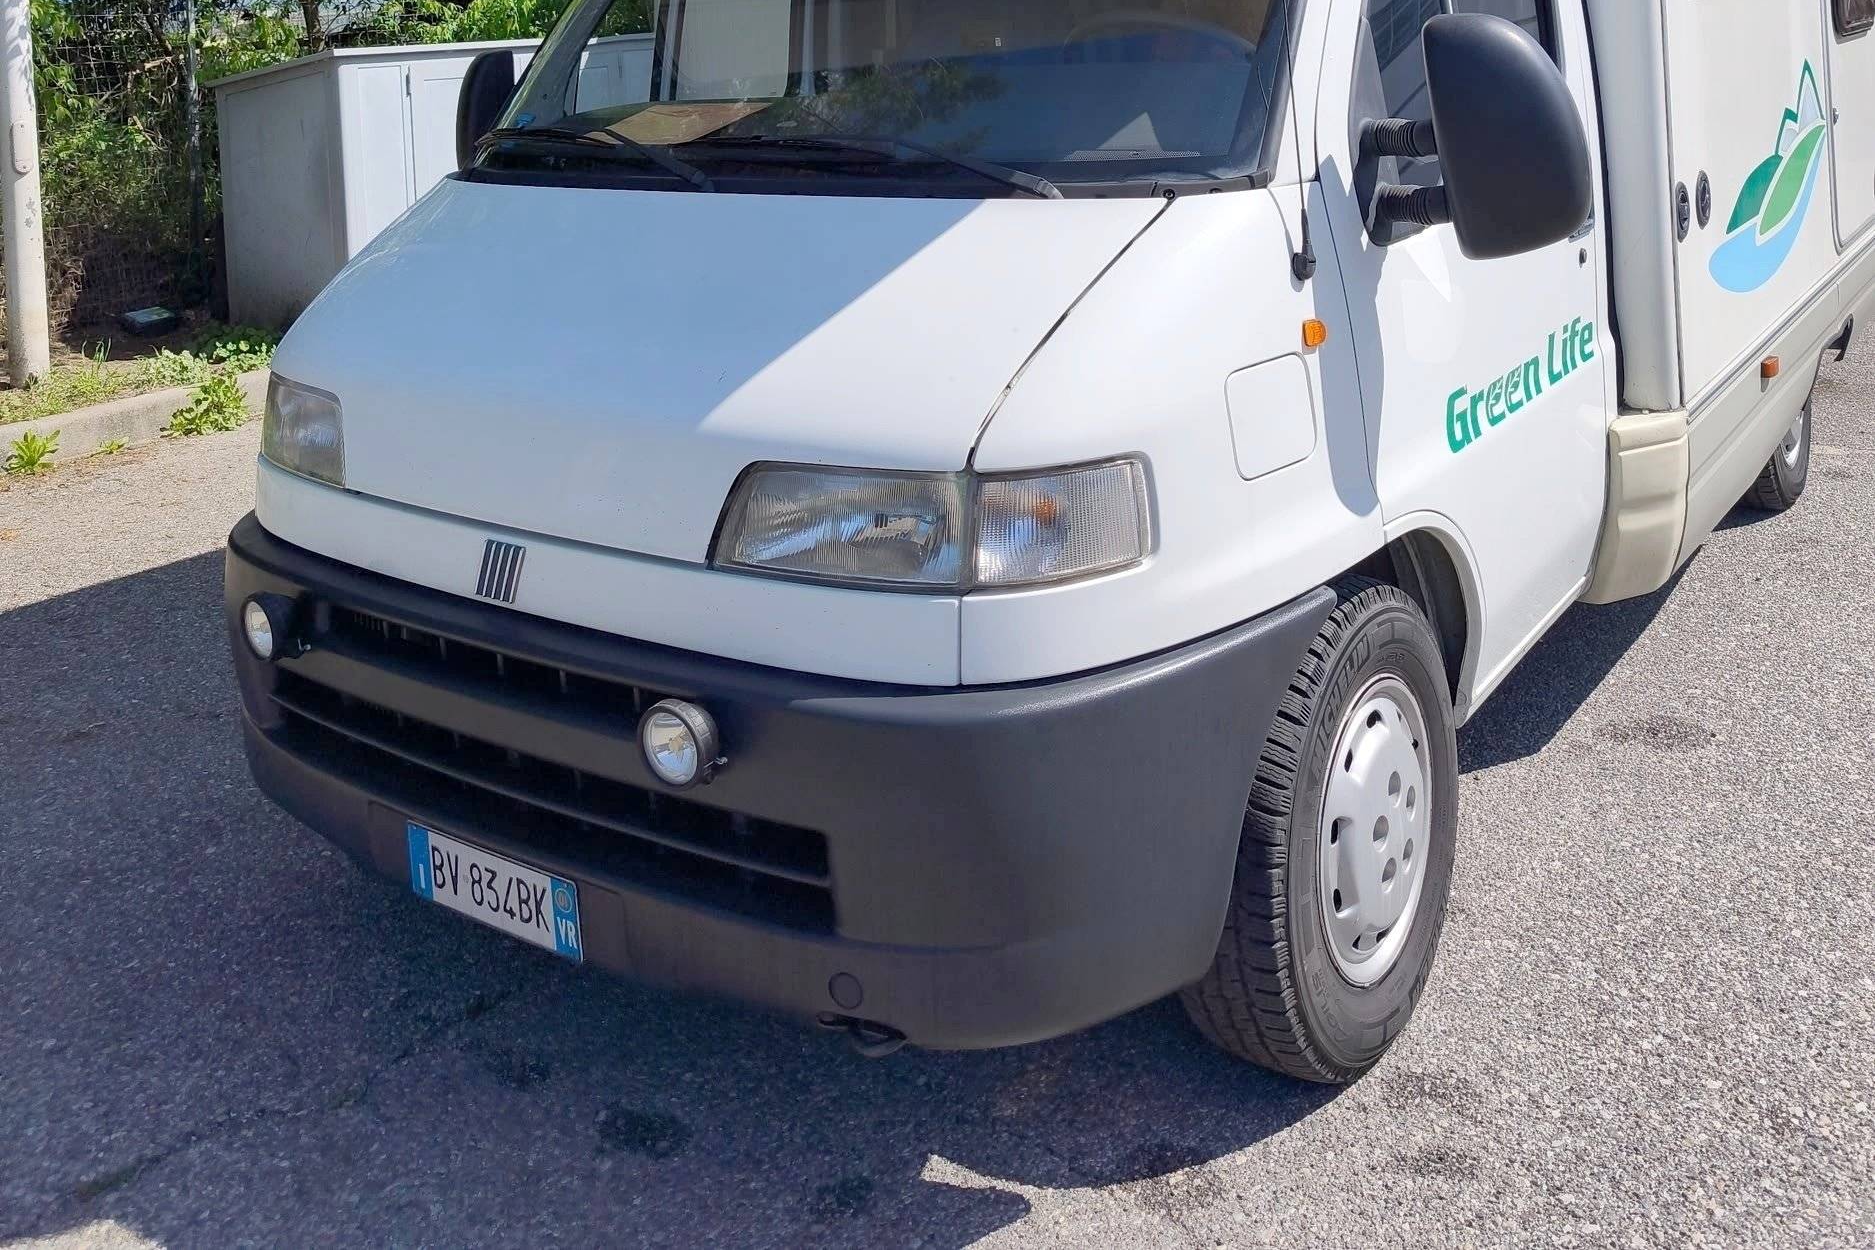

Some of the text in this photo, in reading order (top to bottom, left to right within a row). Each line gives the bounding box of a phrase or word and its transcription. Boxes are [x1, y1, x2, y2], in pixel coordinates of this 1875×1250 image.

[1446, 316, 1595, 454] Green Life
[1311, 634, 1371, 777] MICHELIN
[431, 845, 550, 933] BV 834BK
[556, 916, 578, 949] VR
